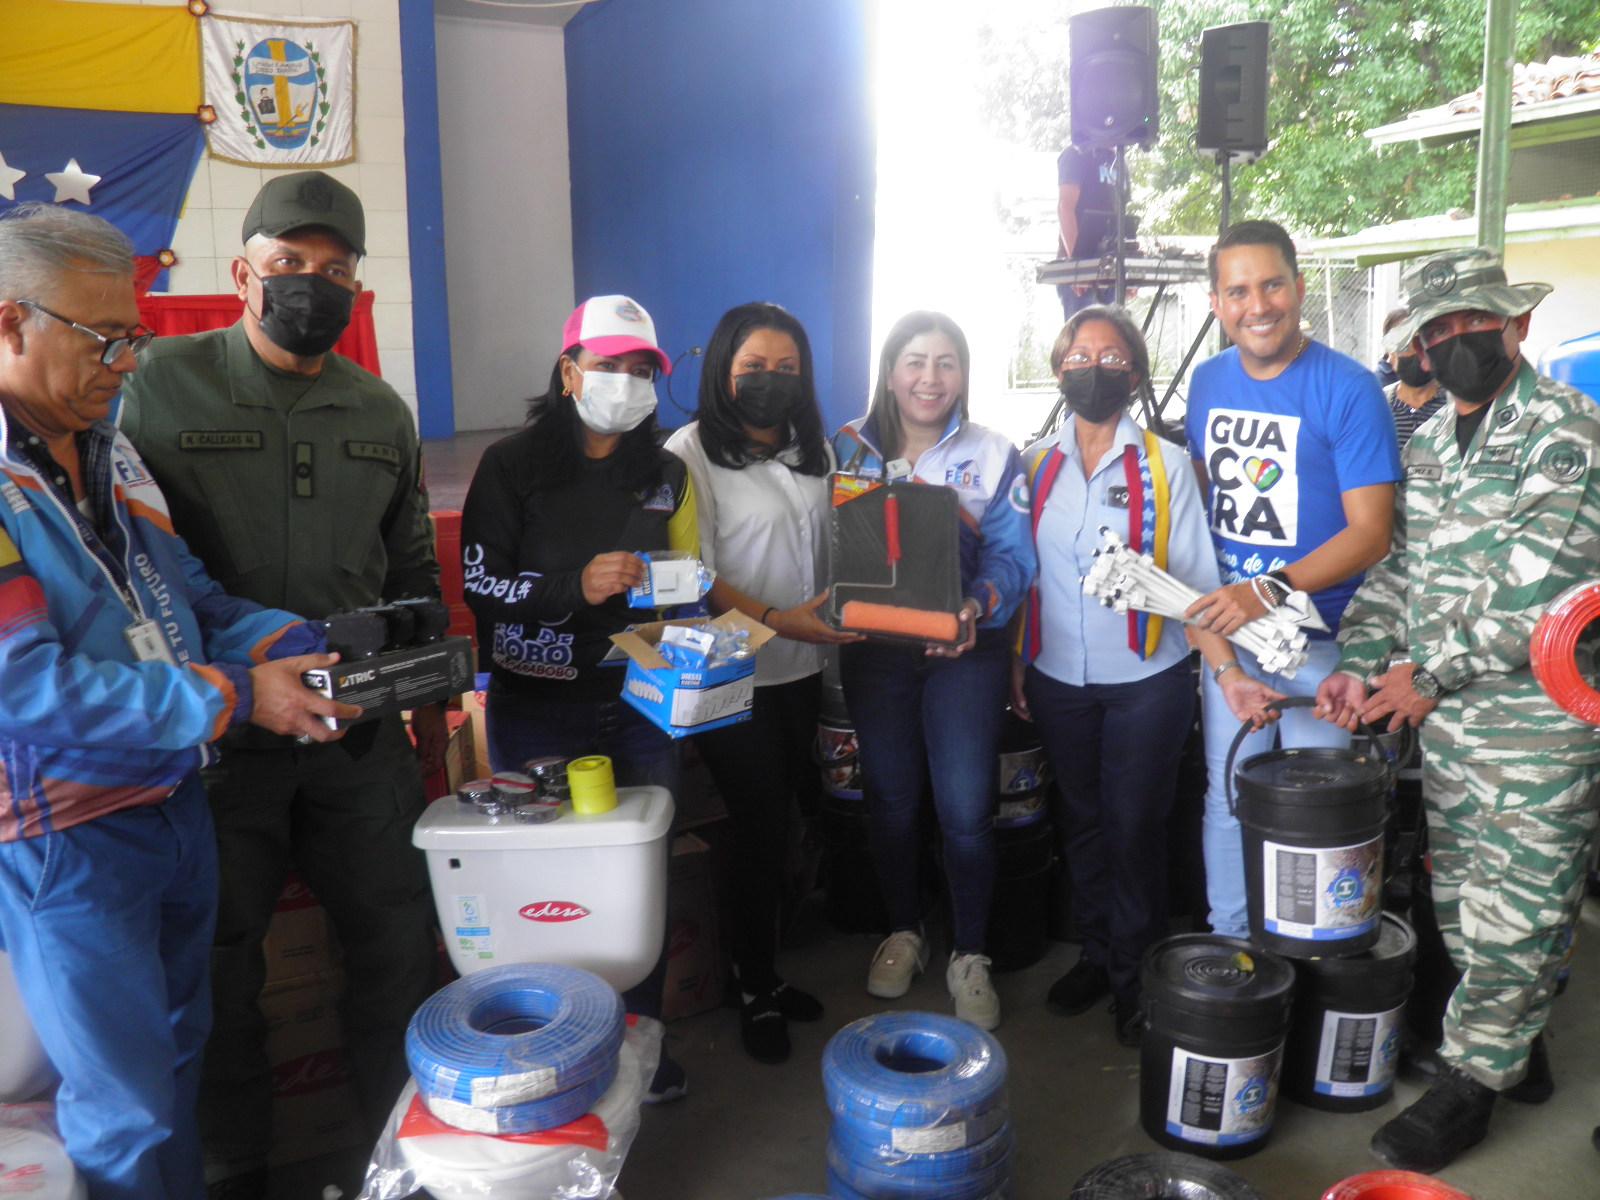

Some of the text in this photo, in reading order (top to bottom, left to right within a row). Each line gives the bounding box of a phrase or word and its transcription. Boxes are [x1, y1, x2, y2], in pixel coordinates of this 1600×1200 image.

[1210, 414, 1287, 452] GUA
[944, 470, 981, 487] FEDE
[134, 552, 174, 619] FUTURO
[522, 902, 586, 918] edesa
